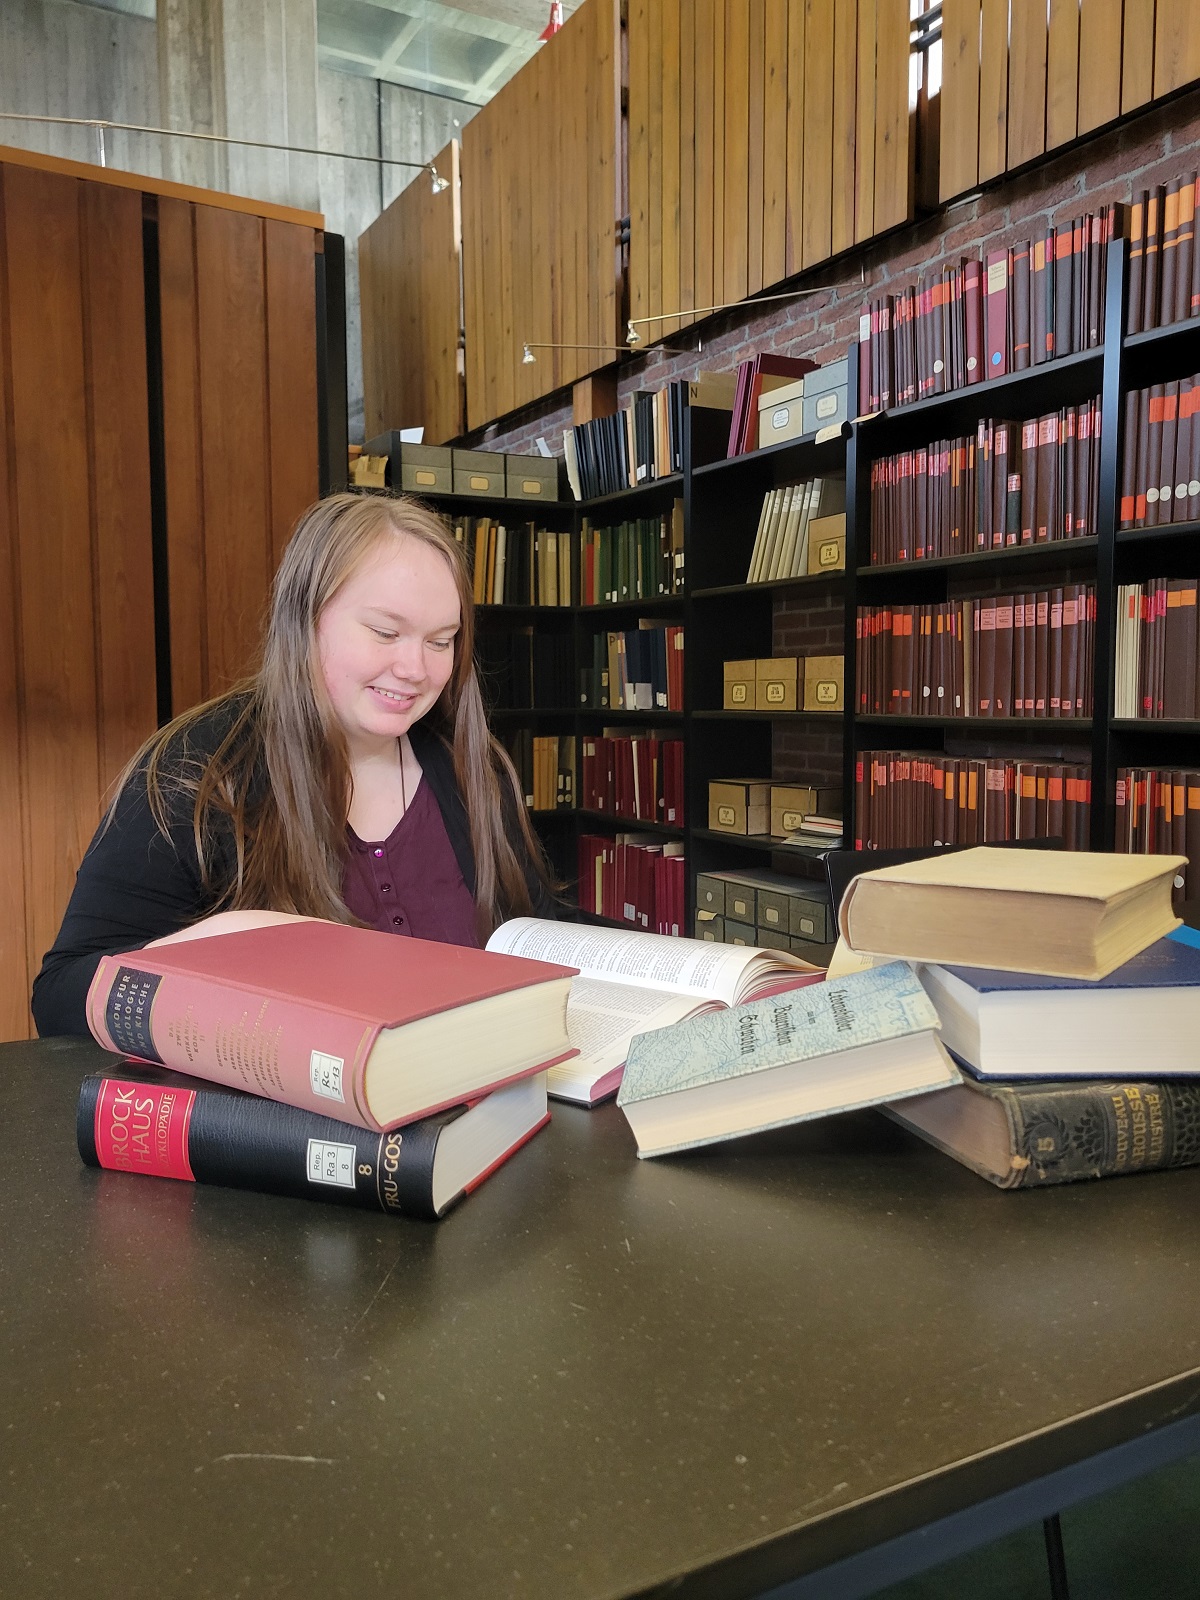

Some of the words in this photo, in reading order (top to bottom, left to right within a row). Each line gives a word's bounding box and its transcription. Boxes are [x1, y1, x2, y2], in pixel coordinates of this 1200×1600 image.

[690, 386, 699, 399] N
[609, 635, 616, 647] P
[124, 982, 139, 1050] THEOLOGIE
[135, 982, 151, 1029] KIRCHE
[110, 1086, 136, 1170] BROCK
[131, 1098, 154, 1165] HAUS
[1122, 1087, 1146, 1165] AROUSSE
[1036, 1137, 1055, 1152] 5
[313, 1152, 323, 1171] Rep.
[326, 1162, 336, 1178] Ra
[358, 1164, 373, 1176] 8
[383, 1133, 403, 1209] FRU-GOS
